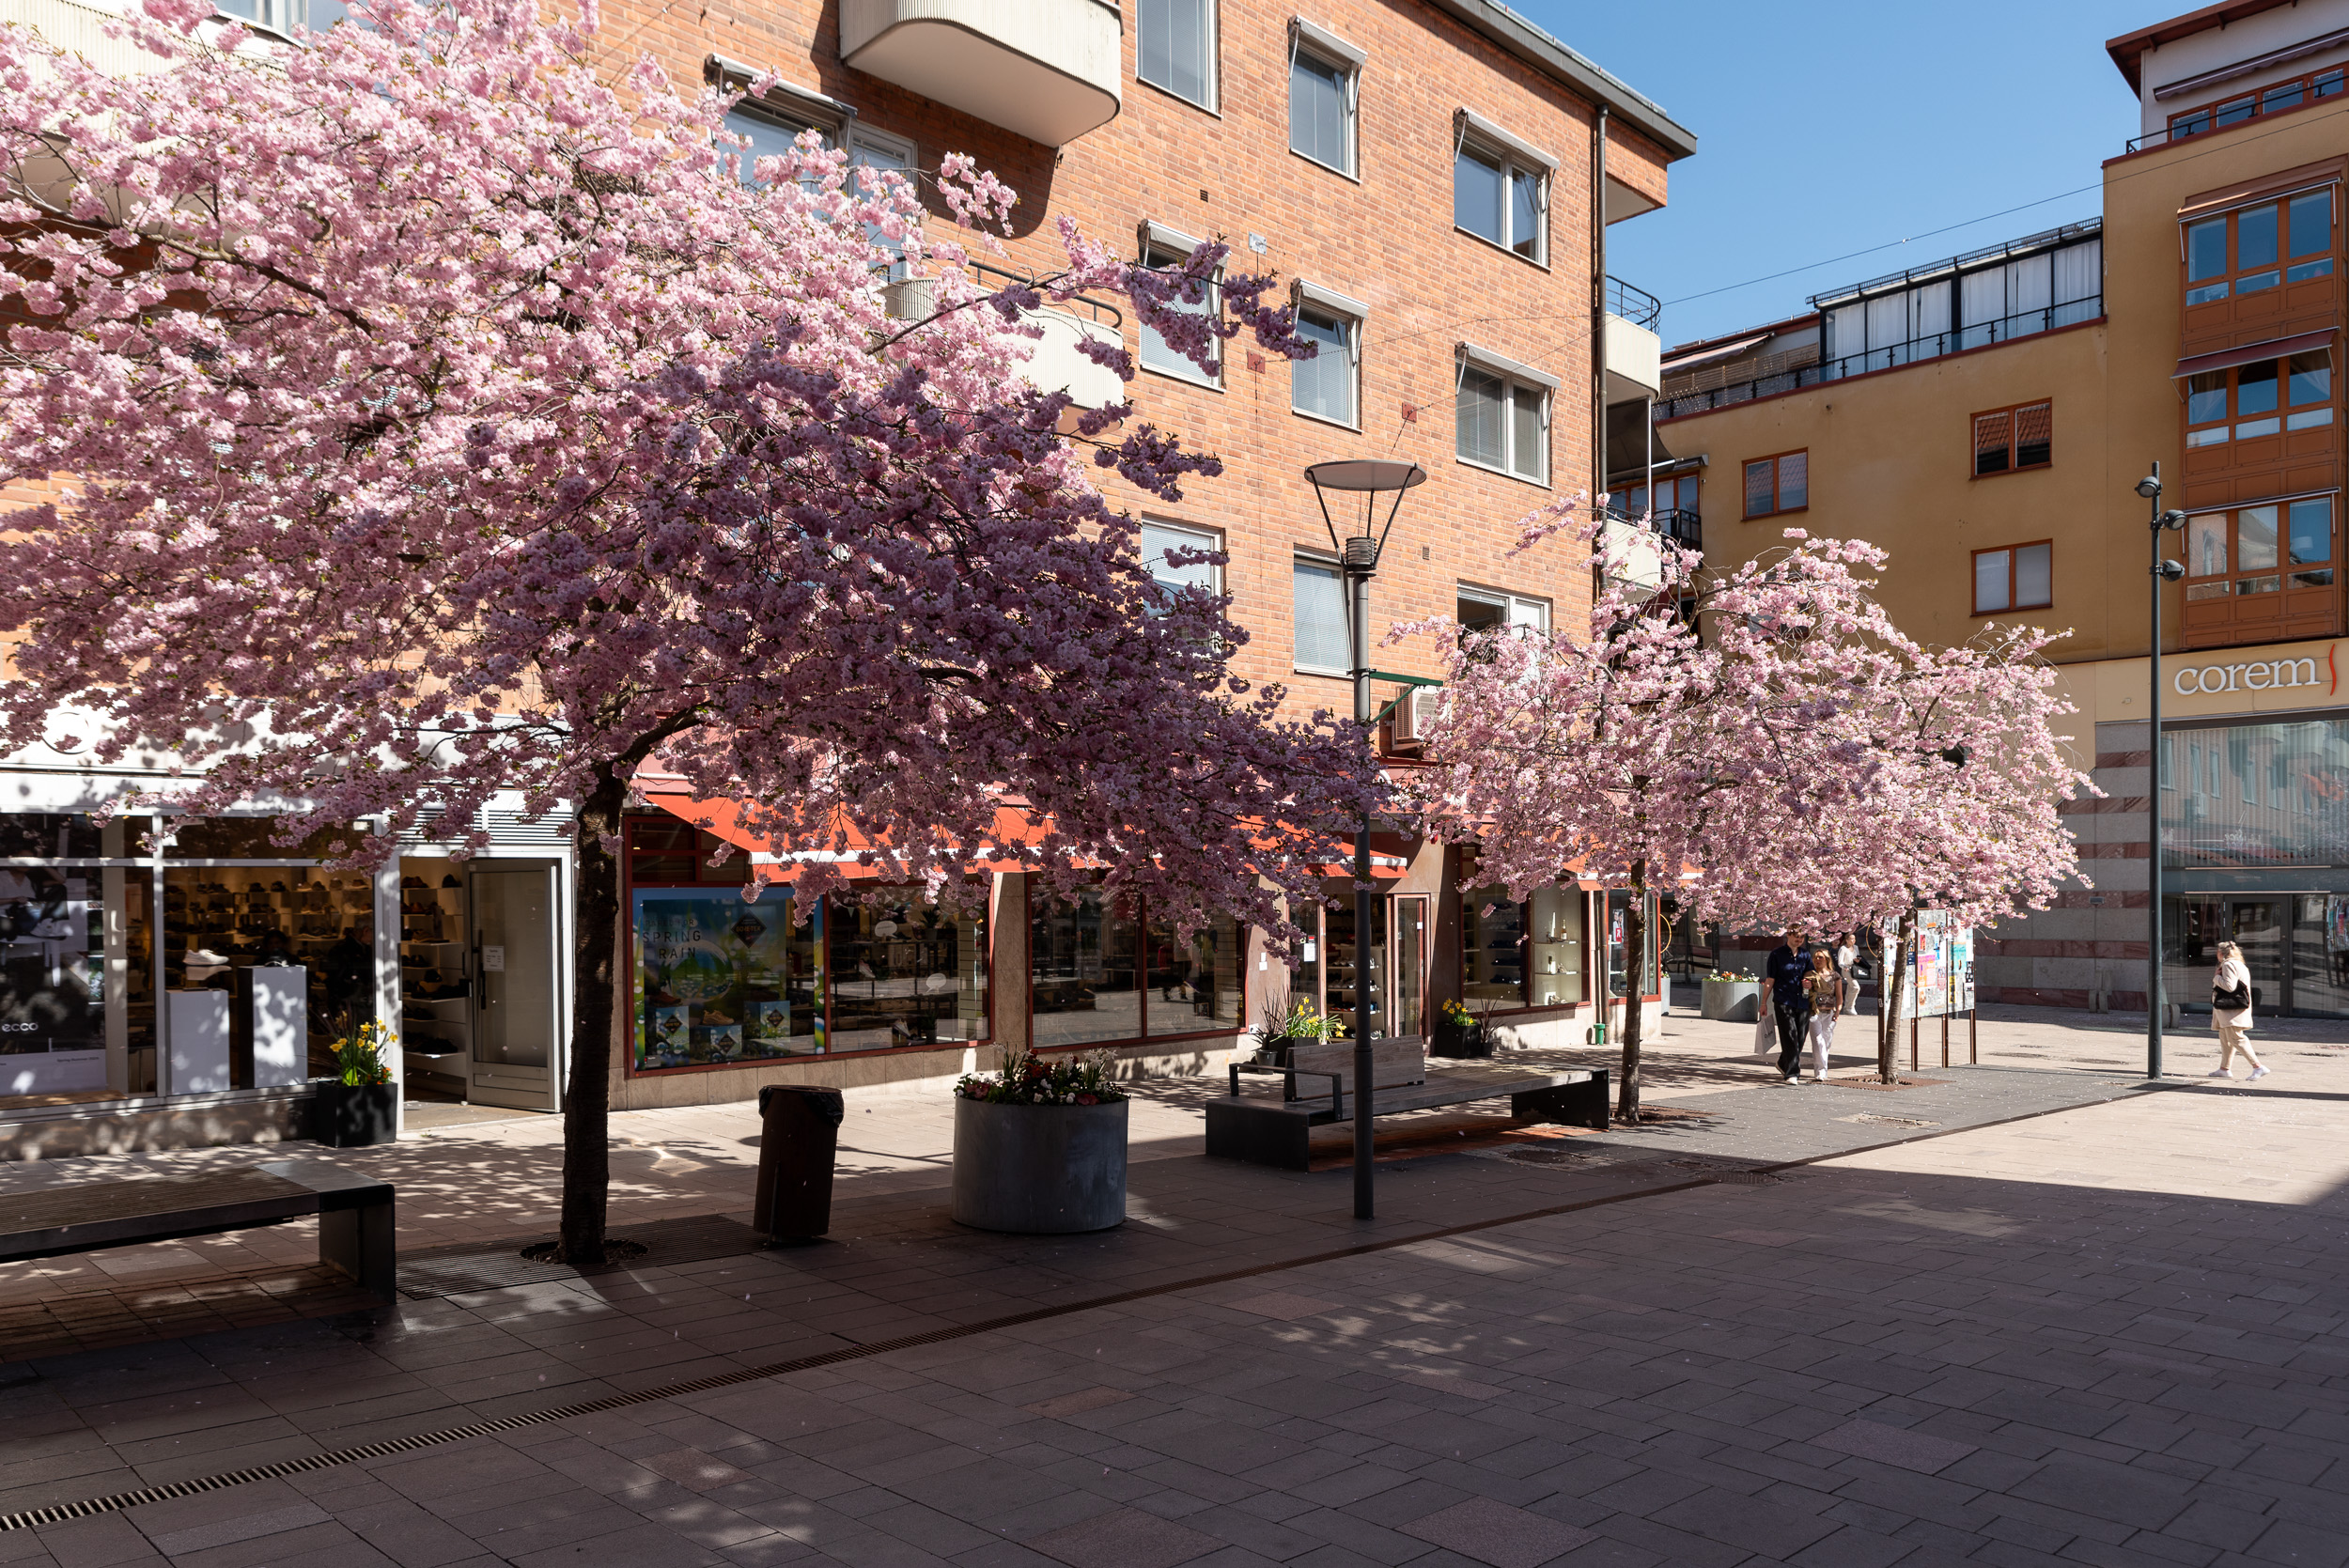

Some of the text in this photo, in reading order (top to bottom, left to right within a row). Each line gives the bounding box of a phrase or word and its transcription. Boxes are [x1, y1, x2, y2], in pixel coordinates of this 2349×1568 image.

[2174, 658, 2321, 695] corem
[643, 930, 701, 943] SPRING
[659, 947, 695, 959] RAIN
[2, 1022, 38, 1032] ecco
